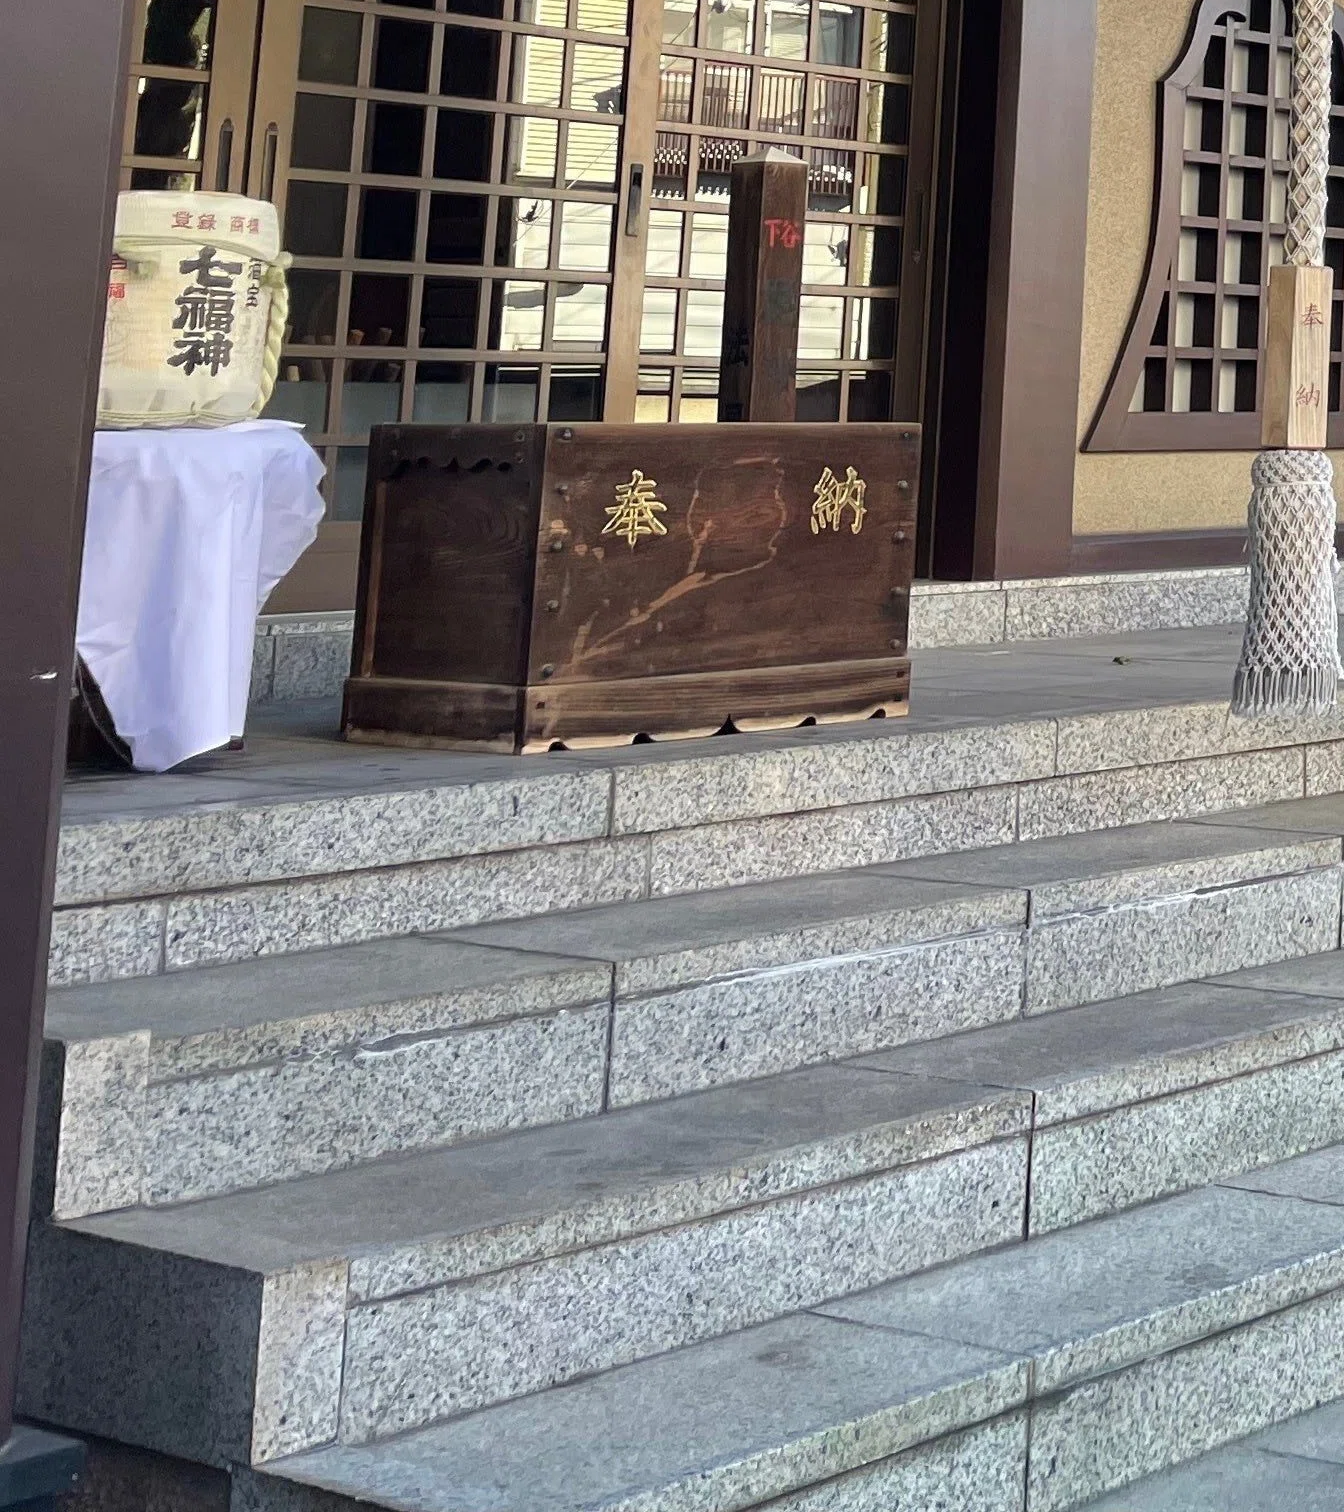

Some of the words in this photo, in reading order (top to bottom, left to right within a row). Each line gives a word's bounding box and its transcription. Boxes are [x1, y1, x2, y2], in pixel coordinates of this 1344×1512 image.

[167, 245, 243, 377] 七福神
[1295, 302, 1325, 409] 奉納
[604, 465, 868, 548] 奉納
